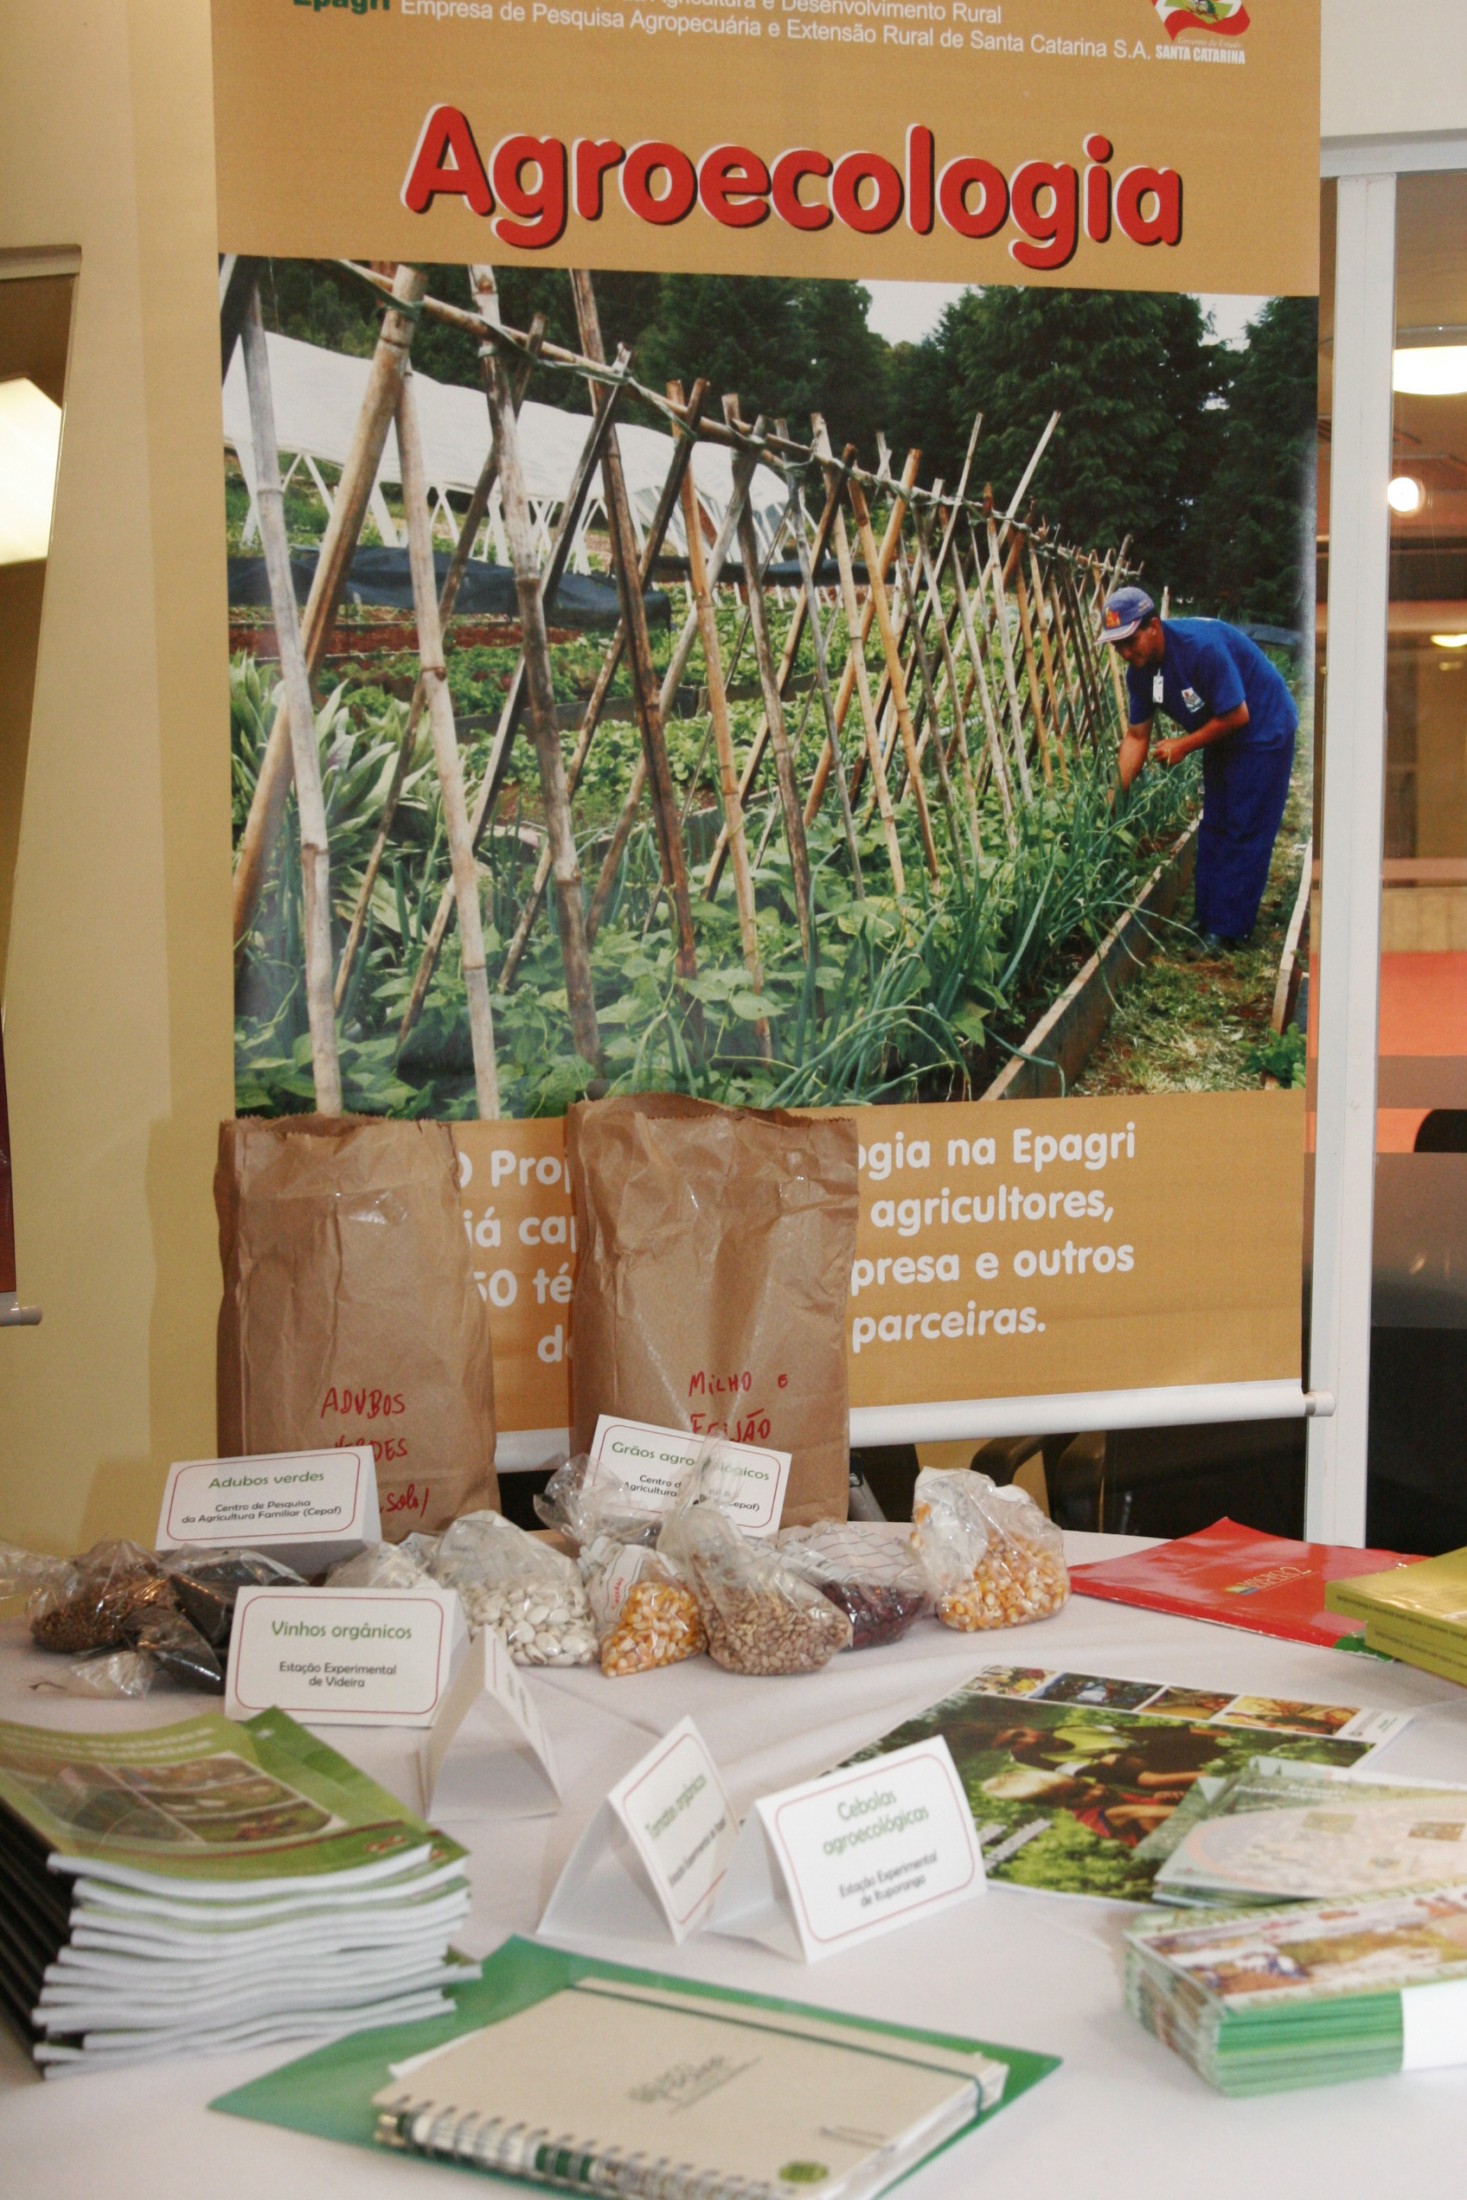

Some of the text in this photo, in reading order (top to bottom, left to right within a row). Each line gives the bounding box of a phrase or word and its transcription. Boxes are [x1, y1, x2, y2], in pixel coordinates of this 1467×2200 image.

[781, 0, 946, 20] Desenvolvimento
[952, 3, 1002, 24] Rural
[401, 0, 493, 20] Empresa
[499, 3, 525, 22] de
[532, 3, 624, 30] Pesquisa
[630, 9, 761, 36] Agropecuária
[768, 22, 781, 37] e
[786, 19, 876, 43] Extensão
[883, 25, 934, 46] Rural
[940, 29, 964, 48] de
[970, 30, 1024, 52] Santa
[1030, 34, 1107, 58] Catarina
[1113, 39, 1151, 60] S.A.
[1155, 44, 1246, 65] SANTA CATARINA
[401, 103, 1183, 270] Agroecologia
[948, 1137, 995, 1166] na
[1013, 1122, 1136, 1173] Epagri
[870, 1185, 1114, 1237] agricultores,
[851, 1253, 961, 1297] presa
[975, 1251, 999, 1280] e
[1013, 1240, 1135, 1278] outros
[537, 1301, 1046, 1363] d parceiras.
[611, 1442, 656, 1460] Grãos
[208, 1470, 325, 1489] Adubos verdes
[639, 1474, 683, 1489] Centro d
[182, 1504, 342, 1524] da Agricultura Familiar (Cepaf)
[215, 1499, 312, 1513] Centro de Pesquisa
[271, 1620, 412, 1641] Vinhos orgânicos
[279, 1661, 397, 1676] Estação Experimental
[308, 1676, 366, 1688] de Videira
[837, 1789, 897, 1821] Cebolas
[822, 1806, 930, 1856] agroecológicas
[838, 1849, 938, 1899] Estação Experimental
[860, 1894, 873, 1907] de
